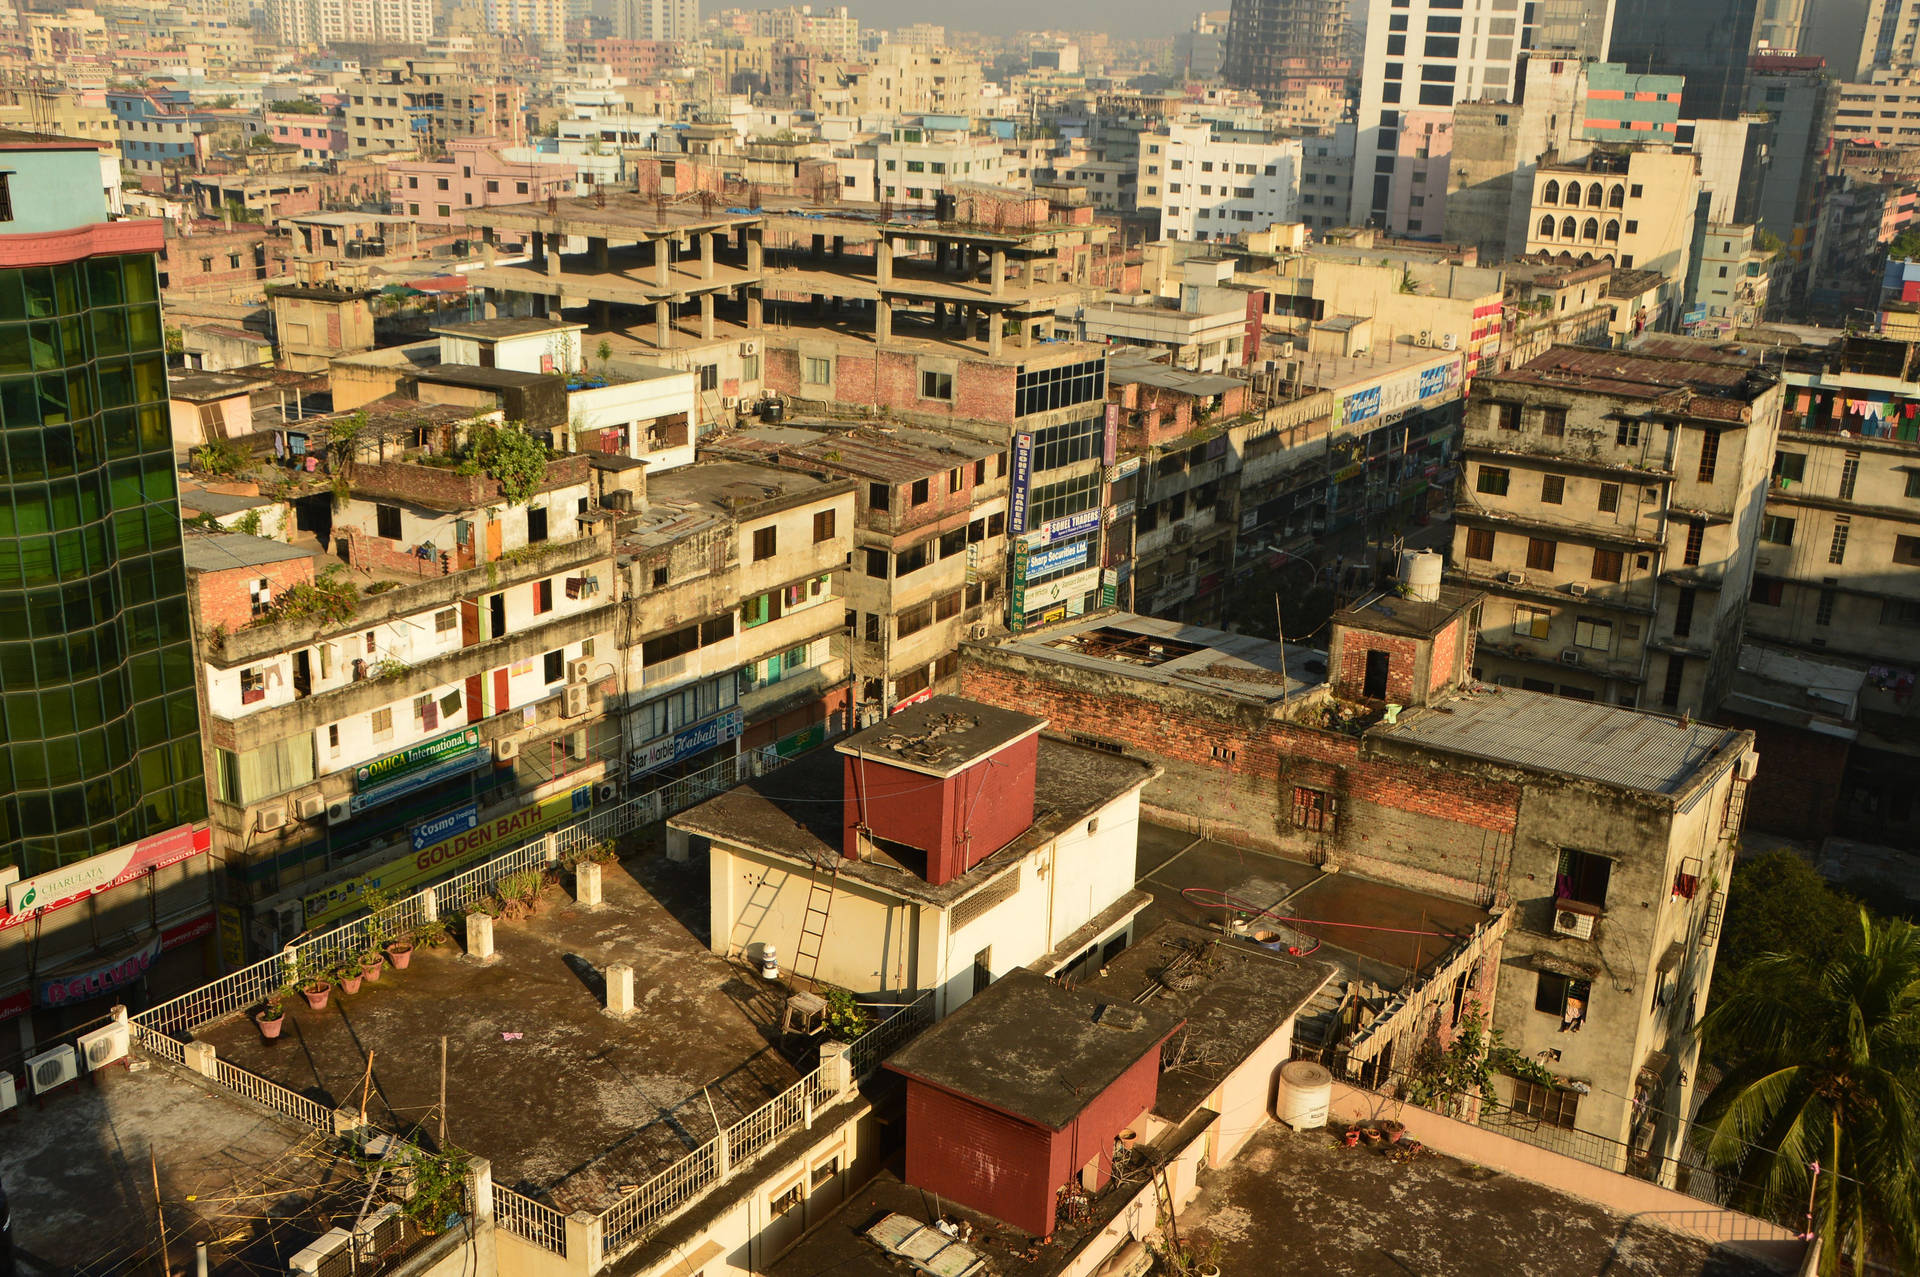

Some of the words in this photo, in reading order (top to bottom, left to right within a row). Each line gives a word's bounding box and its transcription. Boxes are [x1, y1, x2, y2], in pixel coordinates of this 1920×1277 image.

[1018, 449, 1028, 481] SOHEL
[1052, 518, 1070, 533] SOHEL
[1072, 510, 1098, 527] TRADERS
[1031, 556, 1047, 567] Sharp
[1049, 544, 1075, 562] Securities
[369, 753, 407, 776] OMICA
[408, 731, 465, 762] International
[630, 753, 647, 772] Star
[416, 825, 491, 870] GOLDEN
[496, 805, 542, 835] BATH
[420, 816, 455, 837] Cosmo
[41, 867, 103, 895] CHARULATA
[48, 951, 149, 1003] BELLVUE
